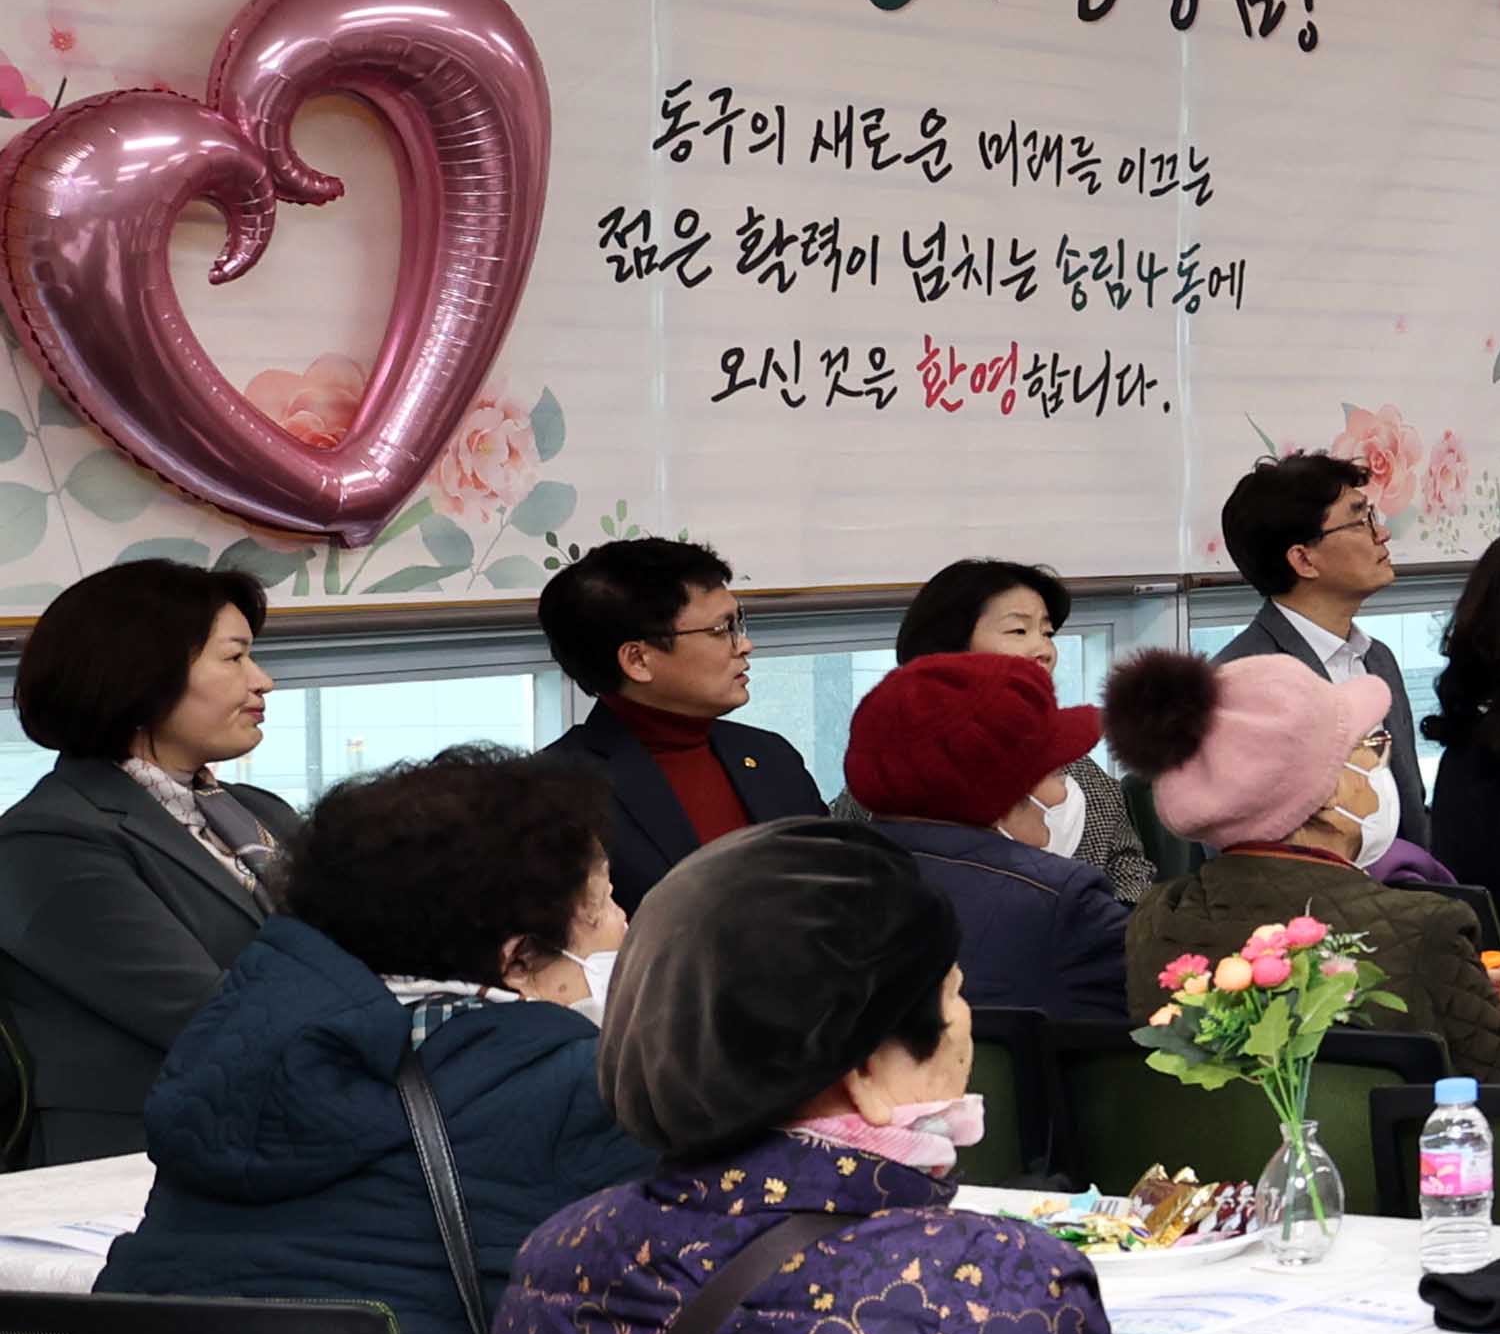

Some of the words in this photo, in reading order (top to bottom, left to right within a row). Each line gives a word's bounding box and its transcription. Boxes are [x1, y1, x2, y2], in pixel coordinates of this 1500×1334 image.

[652, 79, 786, 165] 동구의
[809, 105, 953, 183] 새로운
[979, 120, 1102, 195] 미래를
[1117, 145, 1214, 206] 이끄는
[598, 206, 712, 288] 젊은
[735, 206, 879, 293] 활력이
[903, 221, 1038, 303] 넘치는
[1055, 233, 1247, 314] 송림4동에
[711, 339, 807, 409] 오신
[820, 347, 898, 411] 것을
[916, 333, 1172, 416] 환영합니다.
